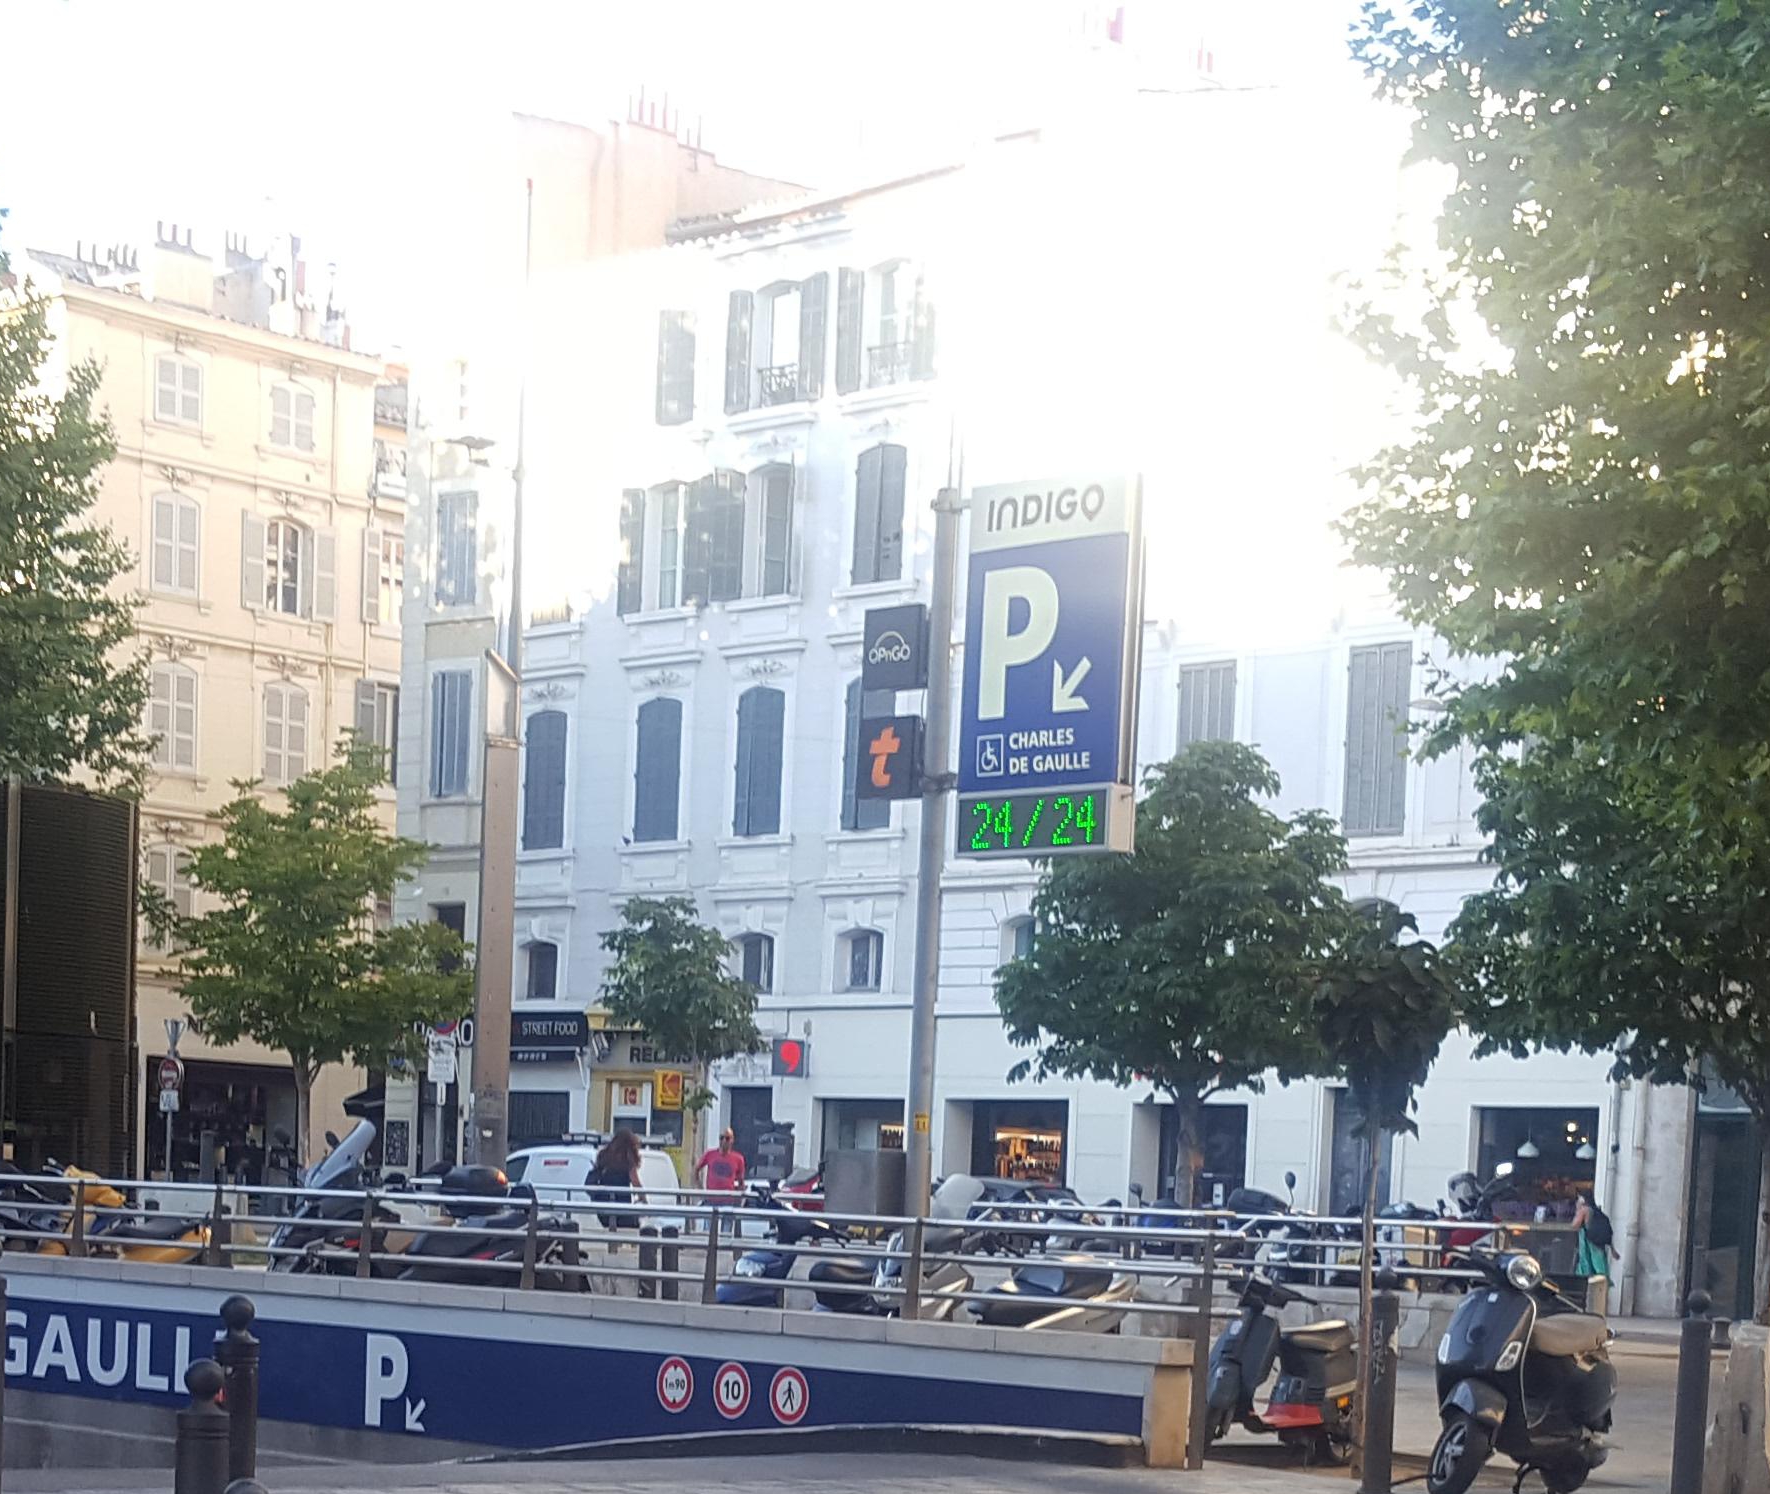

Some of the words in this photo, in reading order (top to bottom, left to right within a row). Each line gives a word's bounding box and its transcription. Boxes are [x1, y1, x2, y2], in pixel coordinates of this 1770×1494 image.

[987, 484, 1105, 532] INDIGO
[978, 566, 1059, 720] P
[1009, 728, 1074, 749] CHARLES
[1009, 756, 1028, 775] DE
[1033, 751, 1090, 773] GAULLE
[554, 1021, 578, 1036] FOOD
[364, 1333, 409, 1427] P
[724, 1379, 741, 1401] 10
